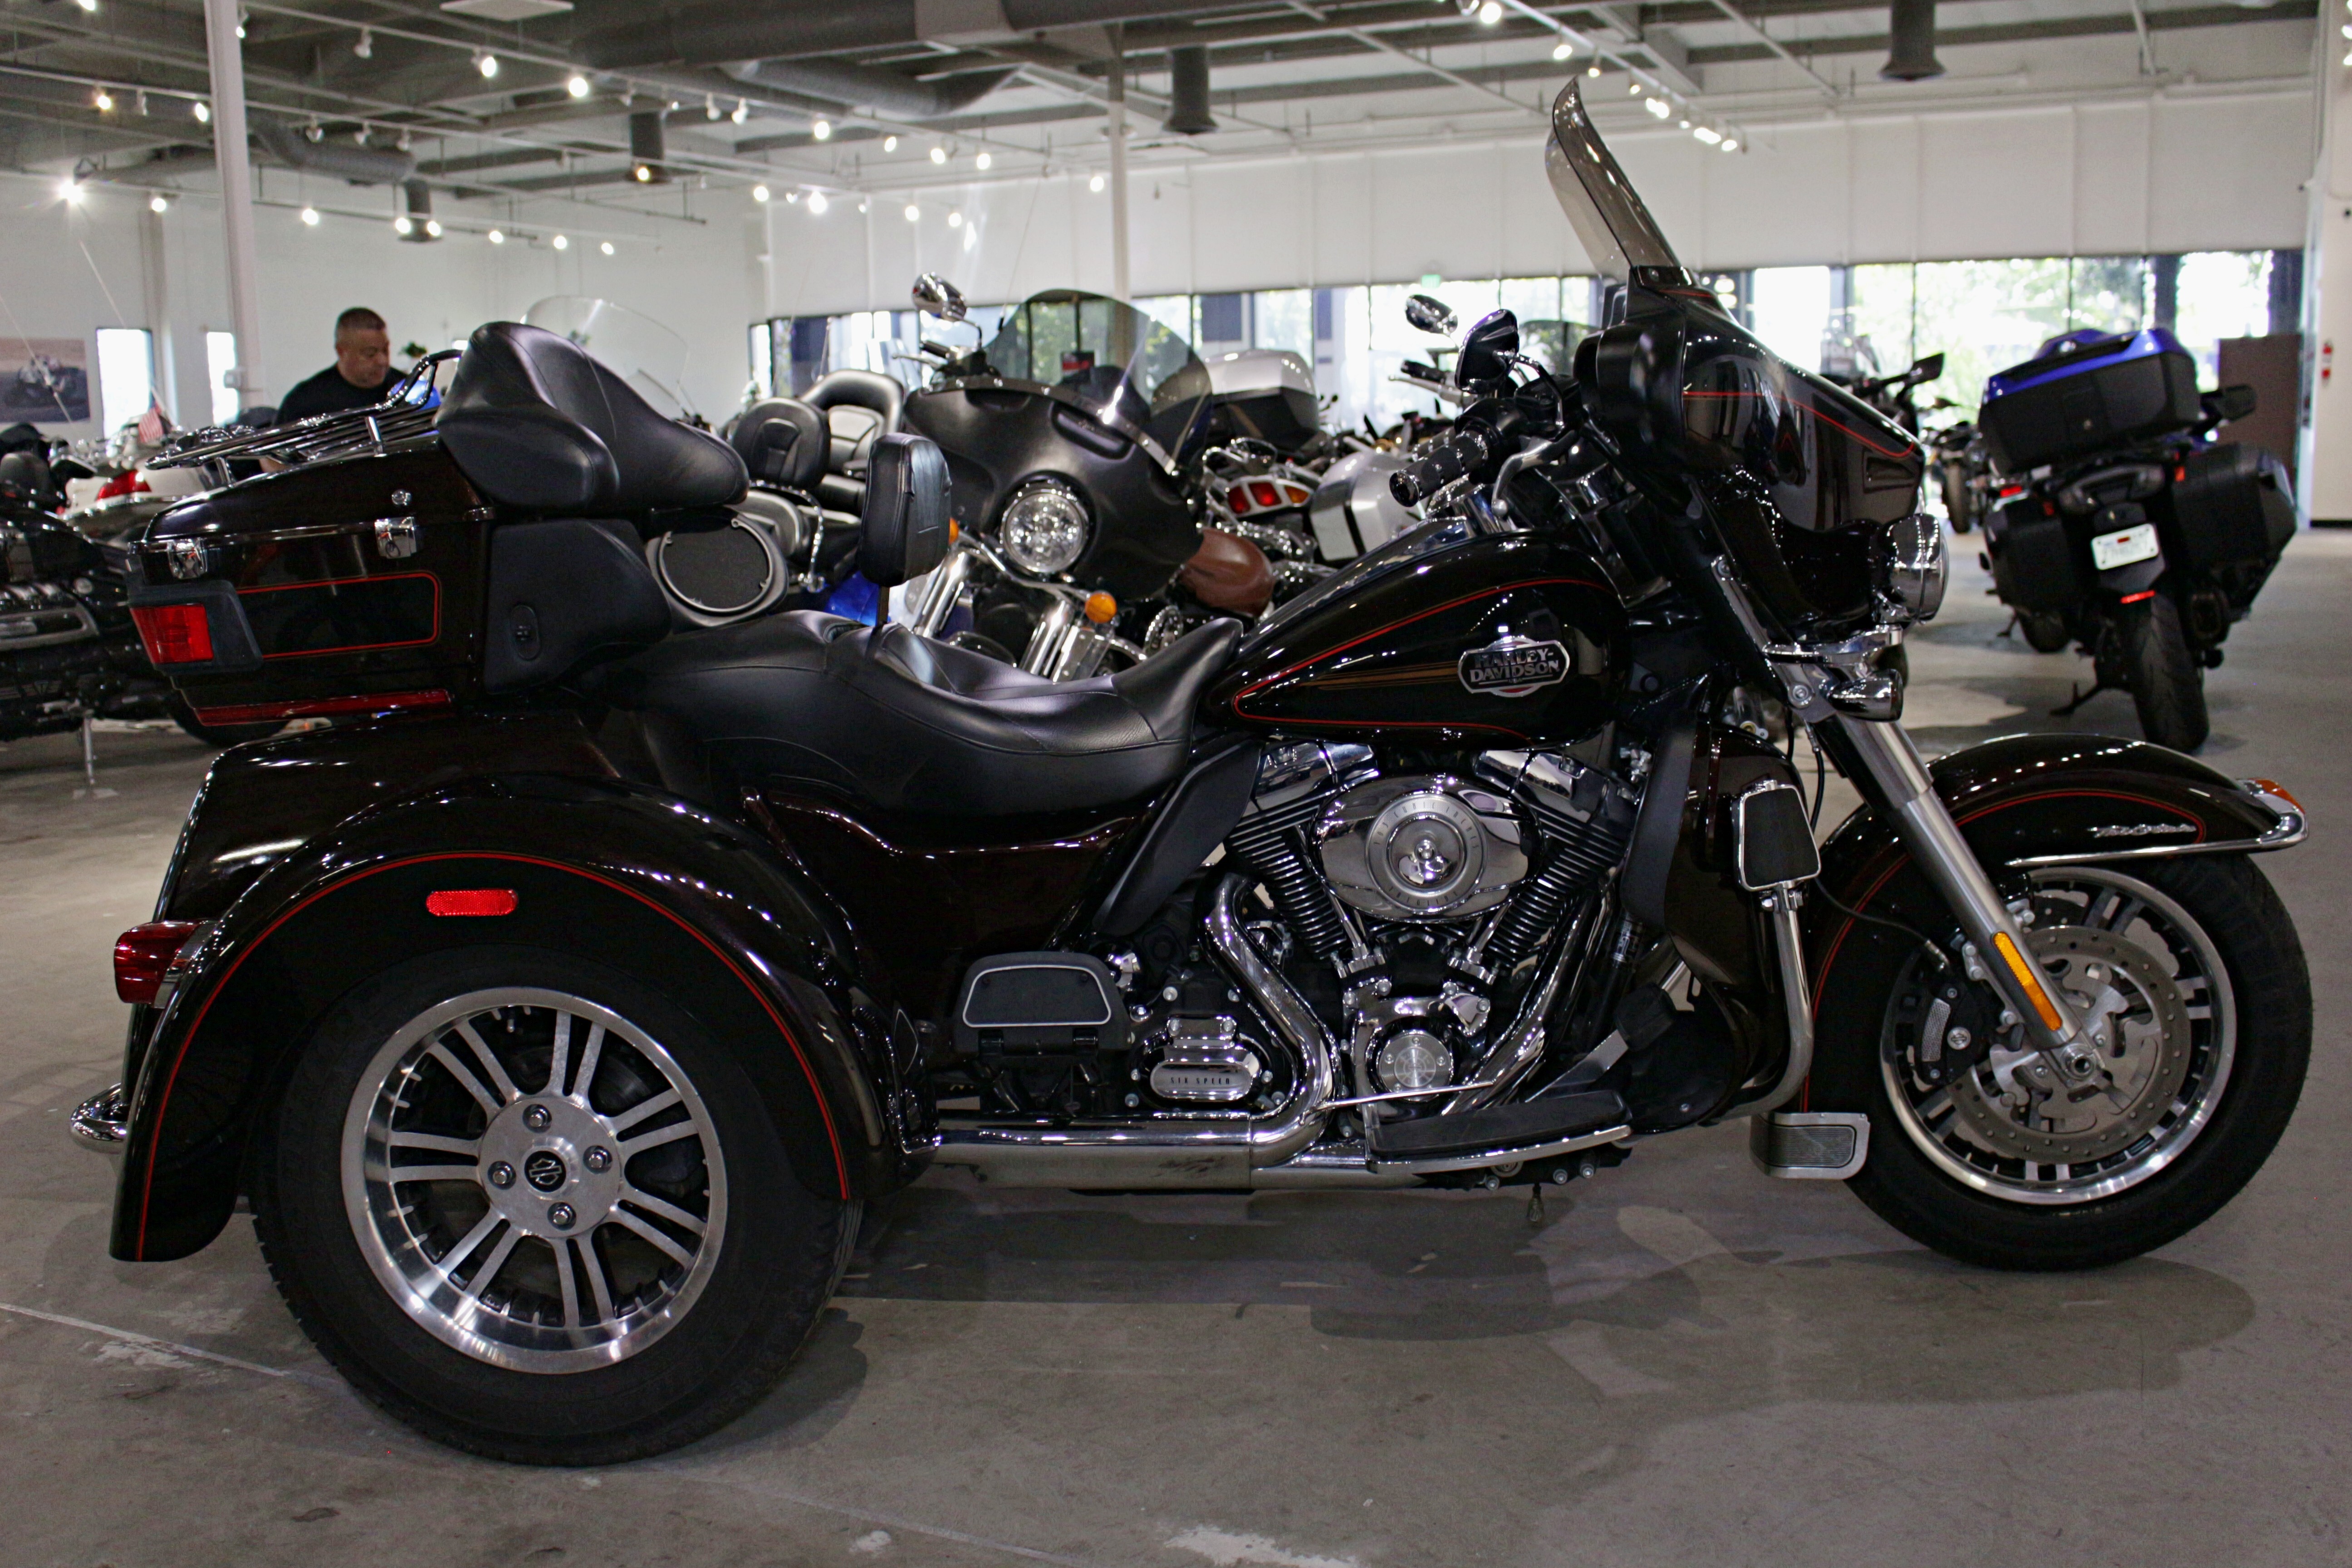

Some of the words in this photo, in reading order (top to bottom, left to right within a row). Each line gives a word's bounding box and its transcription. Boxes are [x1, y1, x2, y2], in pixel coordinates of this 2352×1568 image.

[1474, 648, 1554, 668] HARLEY-
[1469, 660, 1560, 682] DAVIDSON
[1373, 822, 1389, 845] 103
[1394, 802, 1435, 818] CUBIC
[1446, 806, 1479, 848] INCHES
